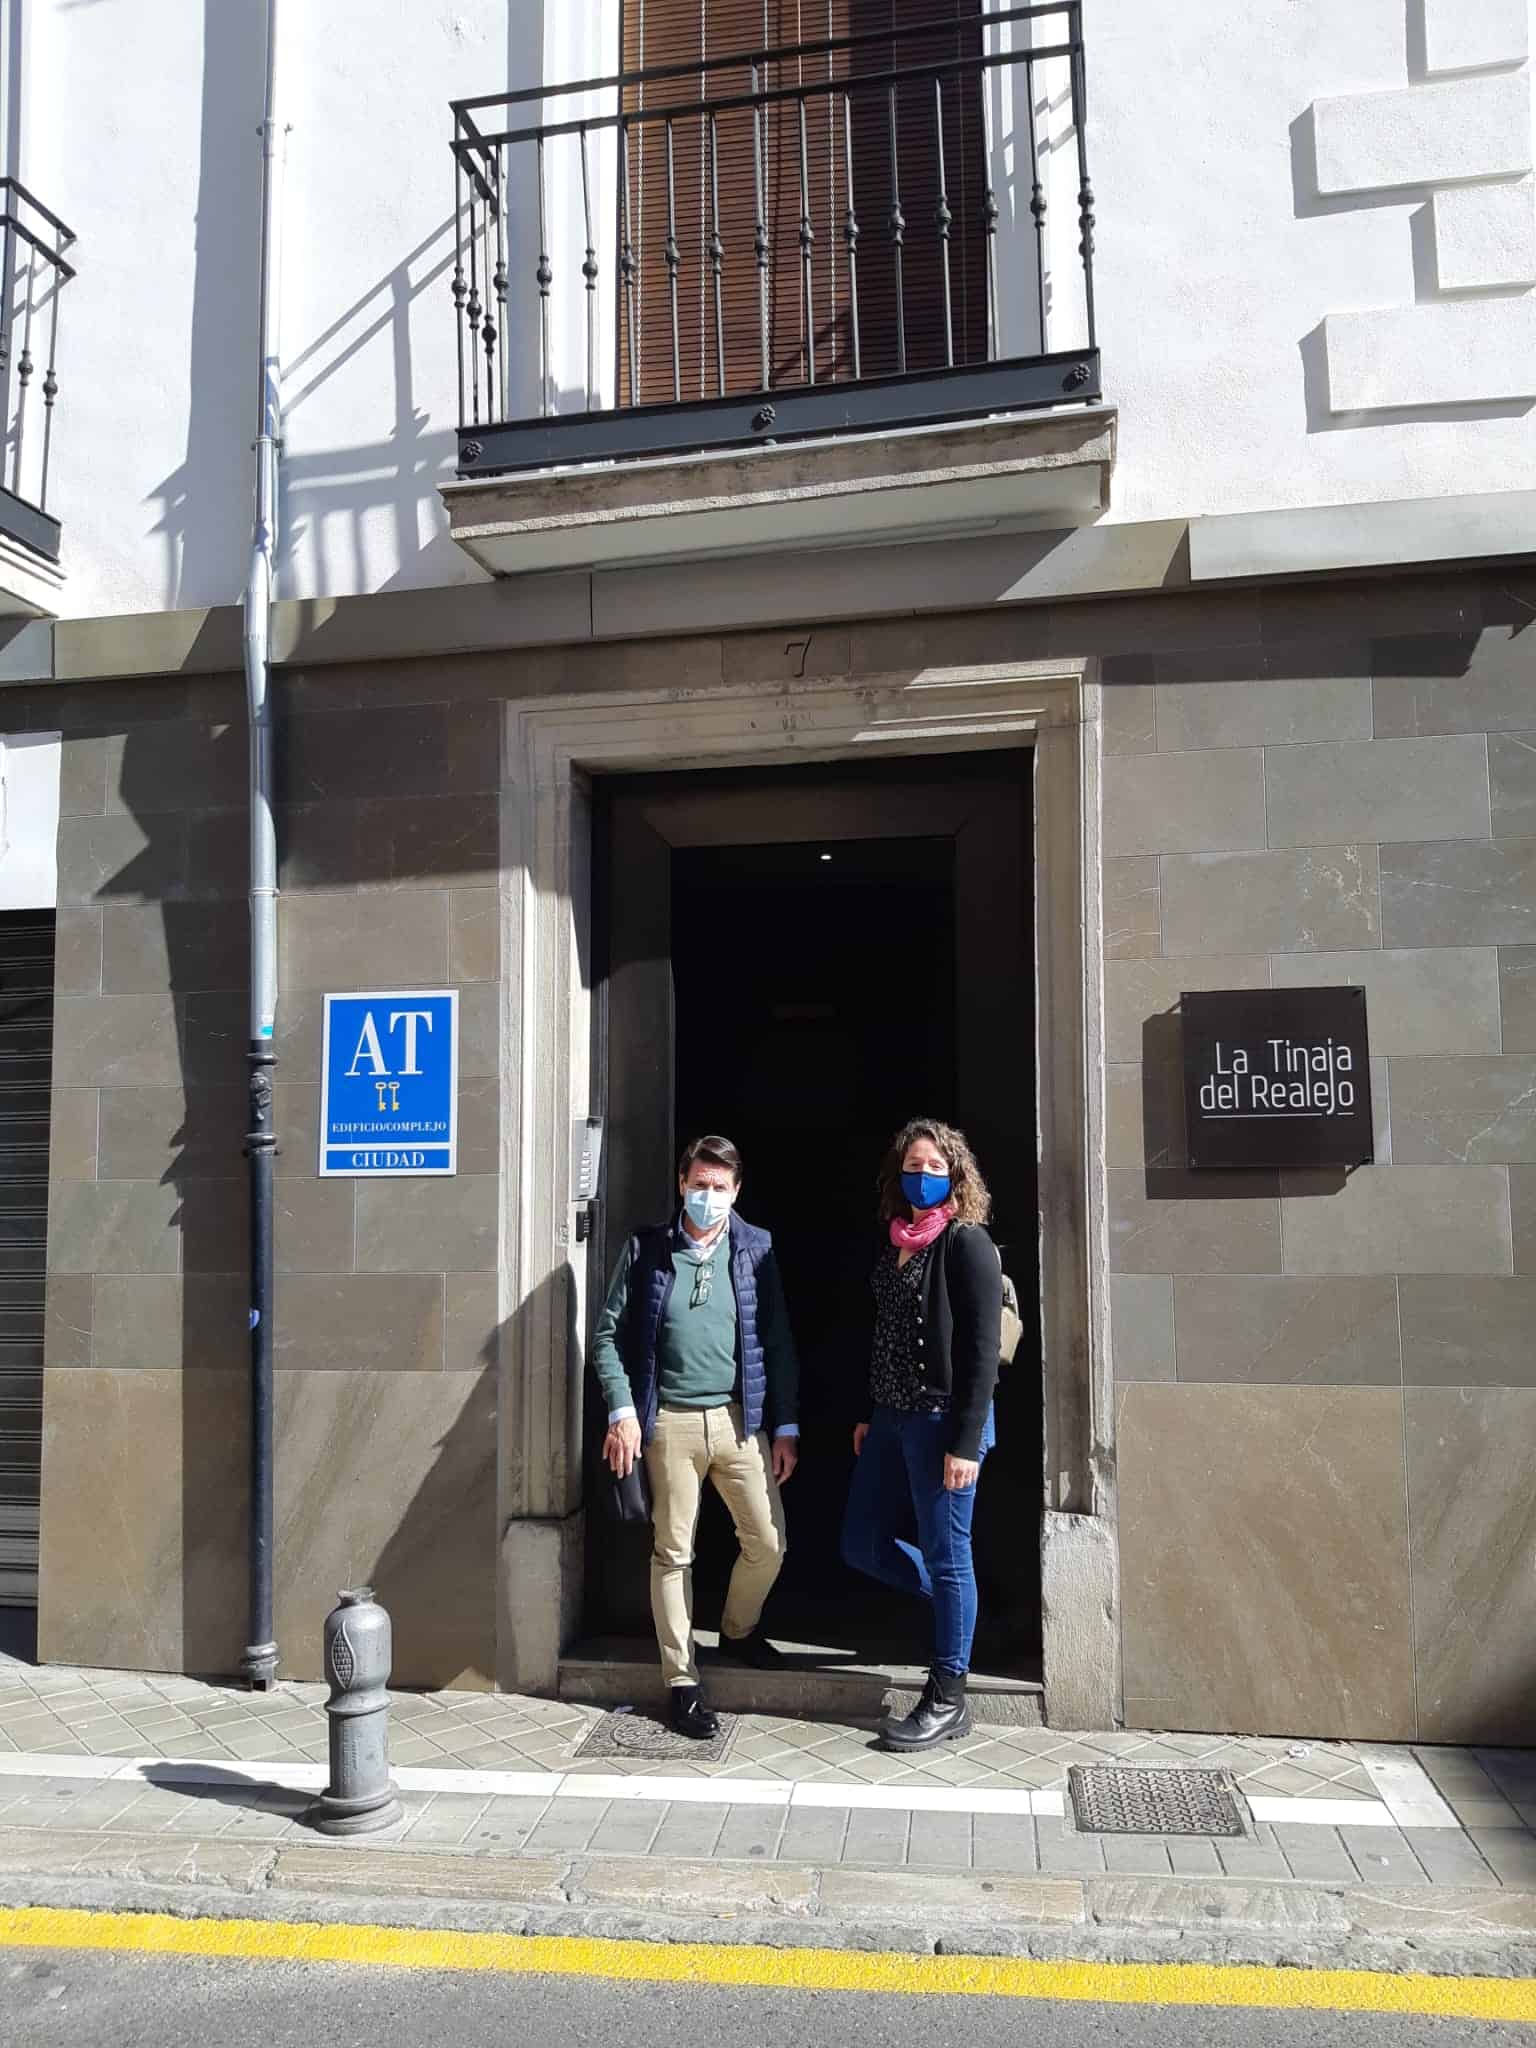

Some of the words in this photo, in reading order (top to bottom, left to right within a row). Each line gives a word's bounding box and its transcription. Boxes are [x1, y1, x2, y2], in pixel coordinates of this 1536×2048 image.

[783, 633, 812, 678] 7
[344, 1011, 433, 1076] AT
[1216, 1041, 1248, 1075] La
[1267, 1037, 1353, 1079] Tinaja
[1200, 1074, 1239, 1110] del
[1251, 1074, 1354, 1115] Realejo
[332, 1121, 447, 1133] EDIFICIO/COMPLEJO
[352, 1151, 425, 1168] CIUDAD
